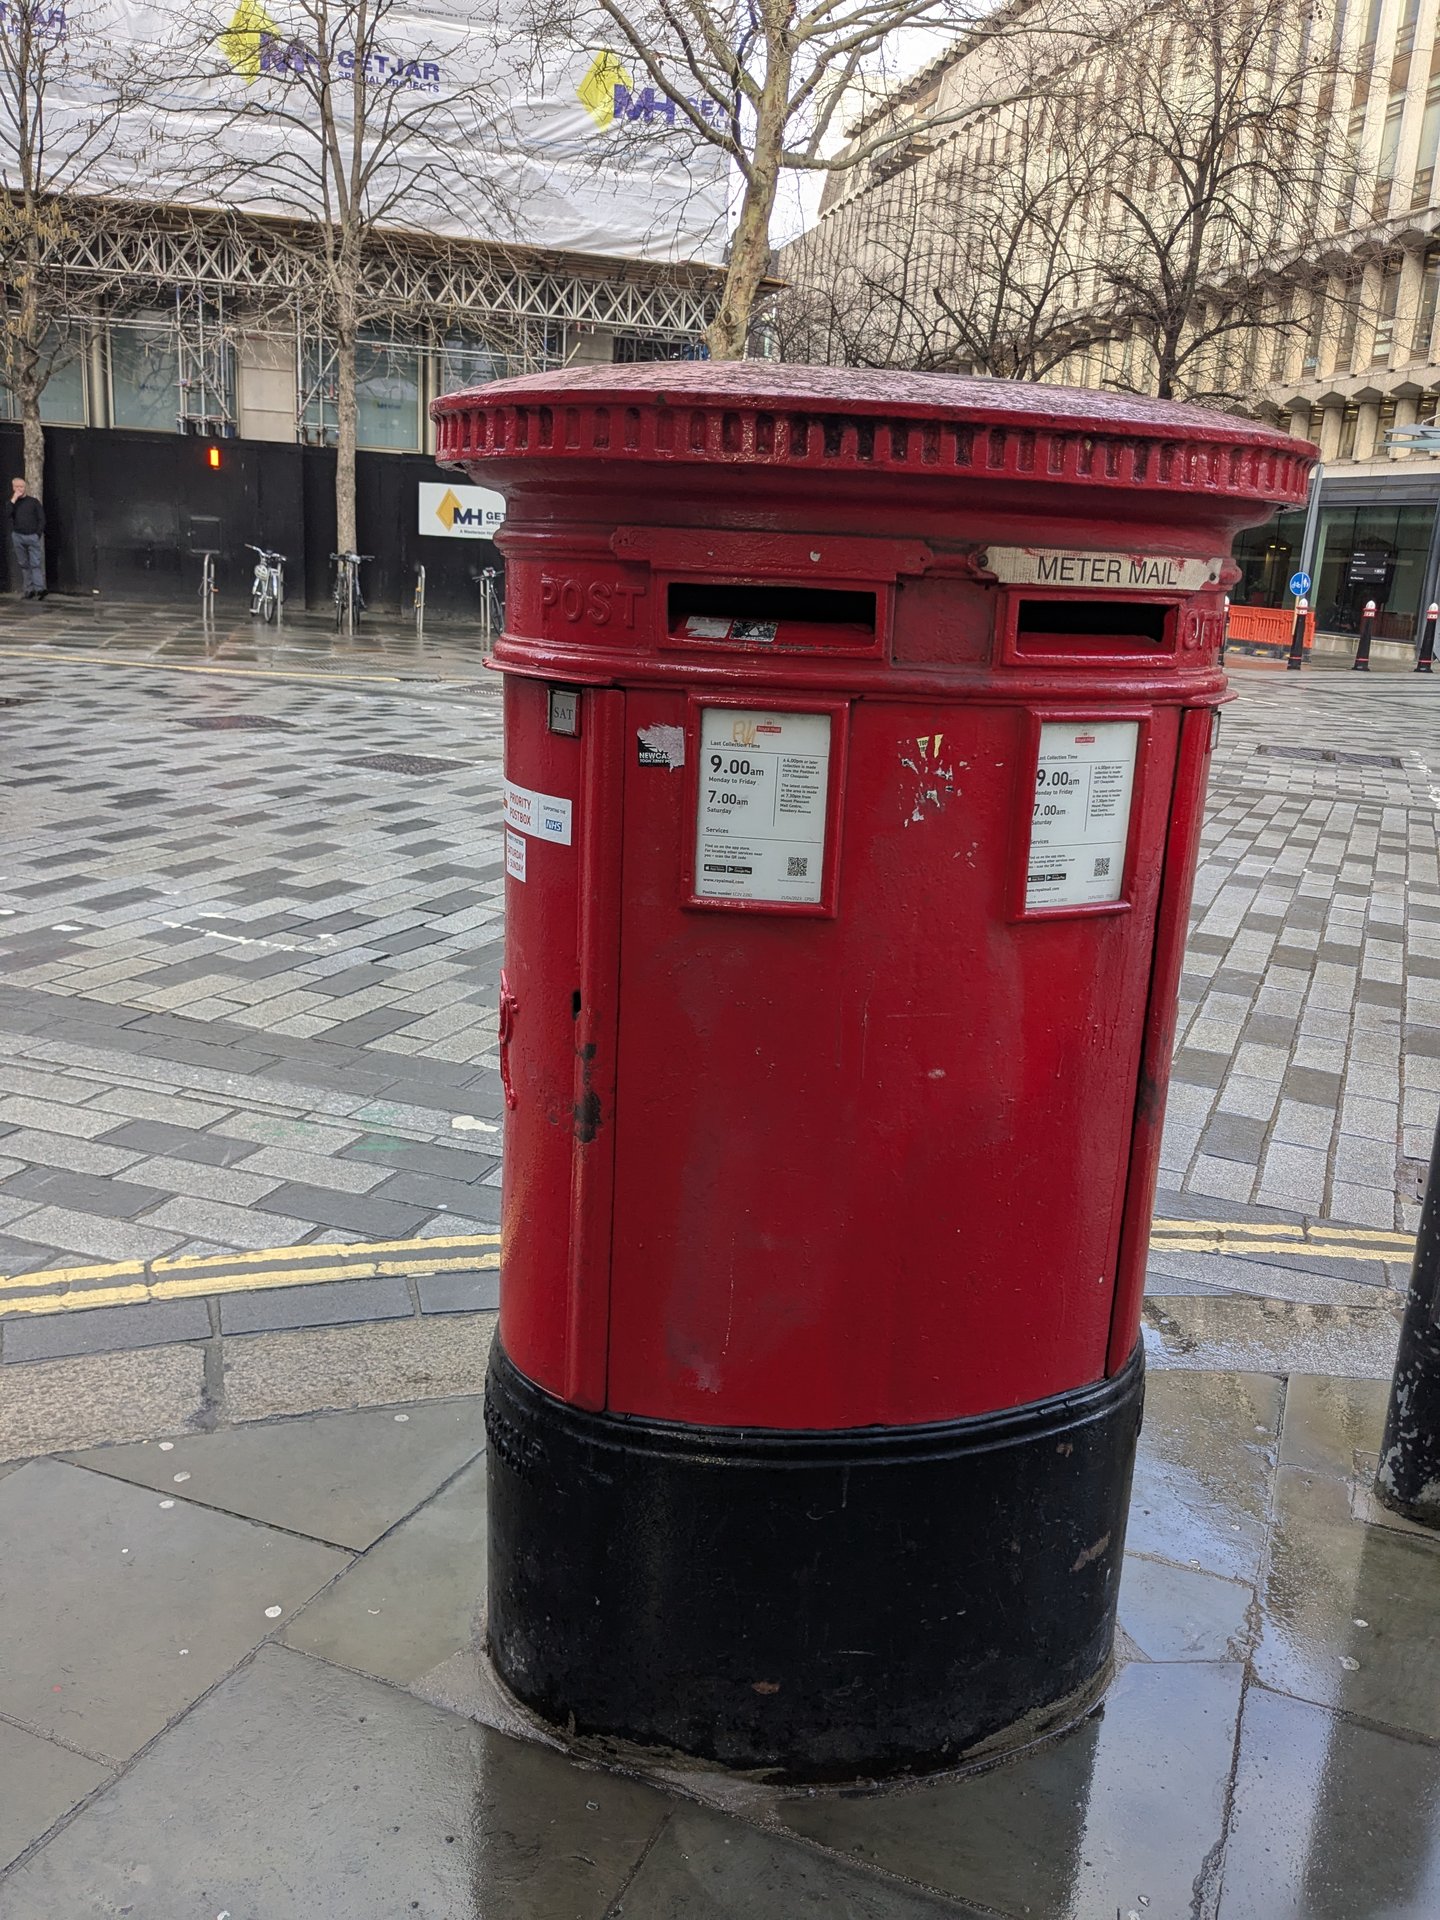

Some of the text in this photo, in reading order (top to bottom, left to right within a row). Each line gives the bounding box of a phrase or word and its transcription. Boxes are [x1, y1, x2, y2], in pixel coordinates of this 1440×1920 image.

[453, 507, 483, 526] MH
[1036, 556, 1178, 585] METER MAIL
[540, 575, 646, 629] POST
[554, 707, 573, 720] SAT
[710, 754, 764, 776] 9.00am
[1036, 769, 1080, 786] 9.00am
[510, 792, 532, 810] PRIORITY
[708, 790, 748, 806] 7.00am
[510, 807, 532, 826] POSTBOX
[1034, 804, 1066, 816] 7.00am
[546, 820, 561, 831] NHS
